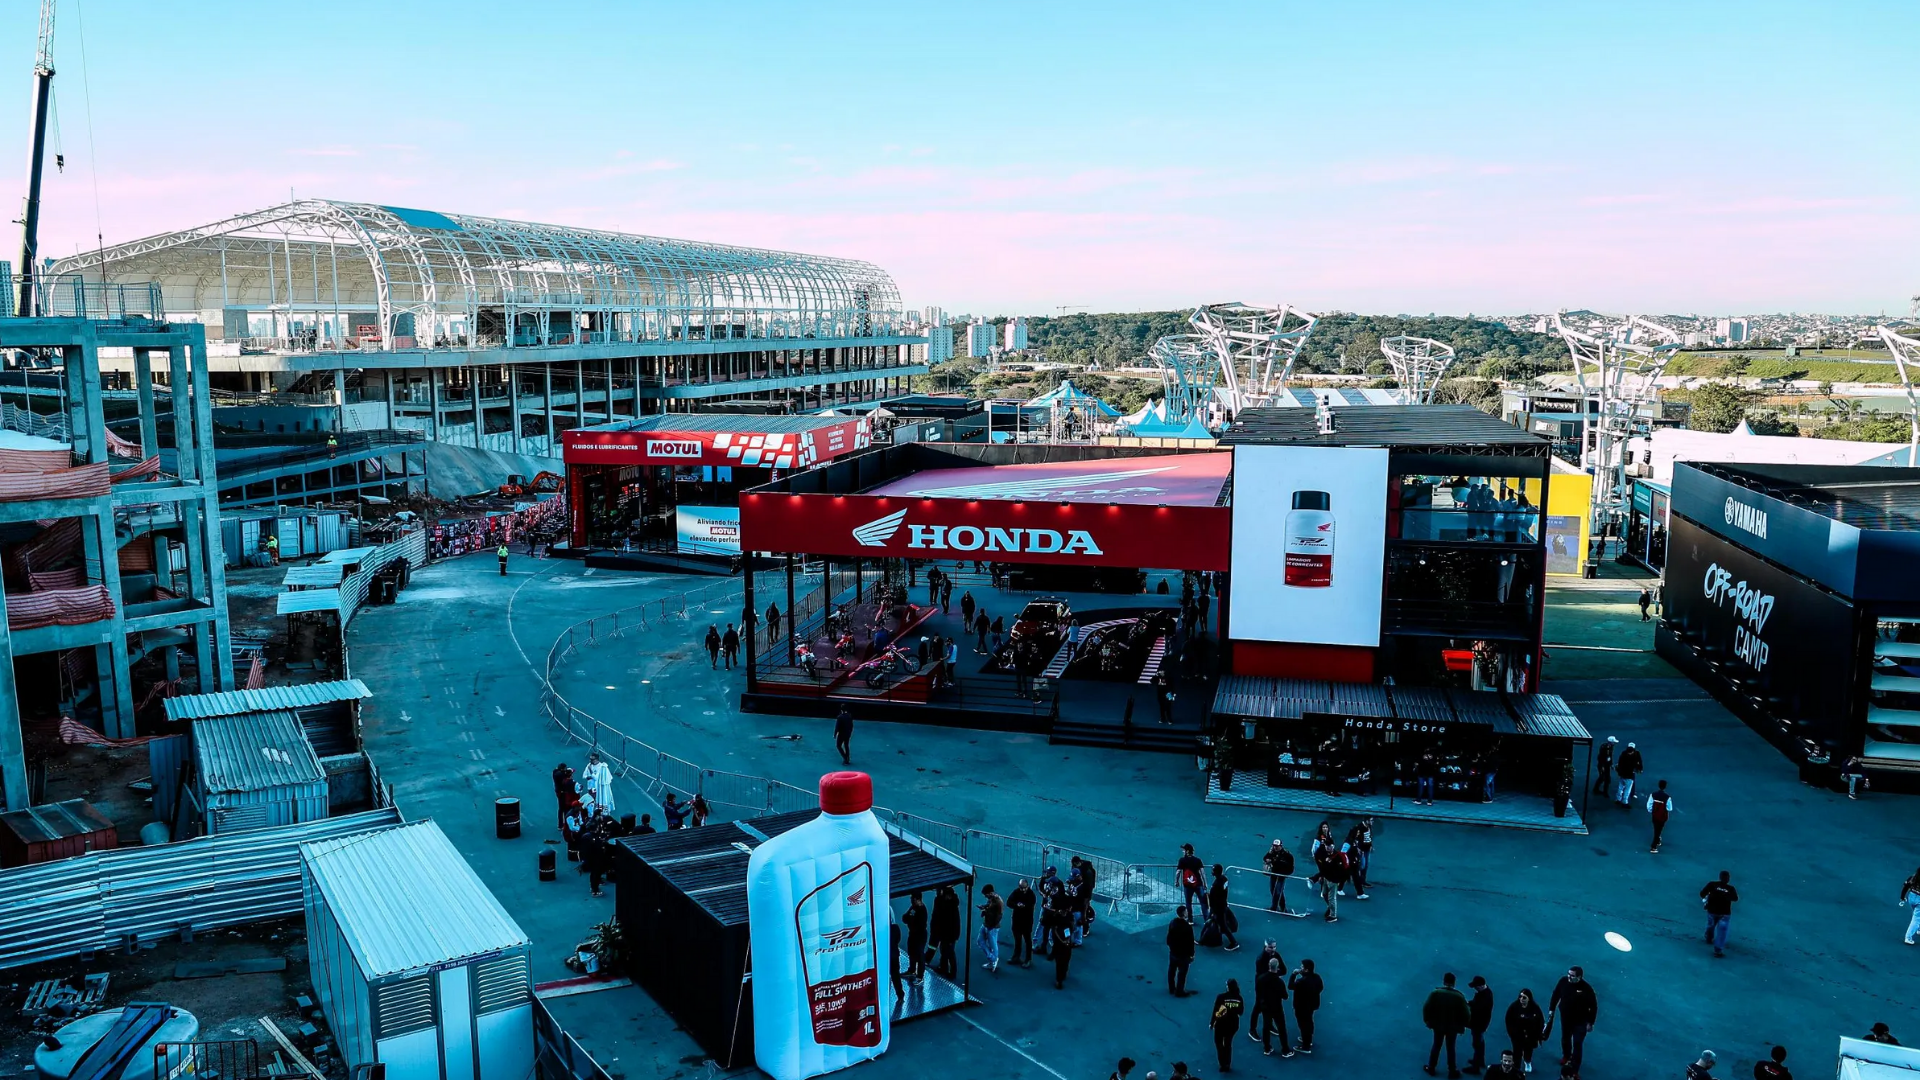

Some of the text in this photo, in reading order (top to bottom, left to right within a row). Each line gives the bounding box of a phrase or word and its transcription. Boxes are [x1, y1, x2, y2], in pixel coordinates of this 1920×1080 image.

[650, 442, 699, 455] MOTUL
[697, 518, 727, 526] Aliviando
[1734, 501, 1767, 540] YAMAHA
[711, 527, 736, 535] MOTUL
[689, 535, 718, 543] elevando
[907, 524, 1104, 555] HONDA
[1704, 562, 1775, 635] OFF-ROAD
[1734, 625, 1770, 672] CAMP
[1345, 718, 1446, 733] Honda Store
[814, 990, 834, 1001] FULL
[834, 976, 872, 996] SYNTHETIC
[815, 1002, 826, 1011] SAE
[863, 1021, 875, 1035] 1L
